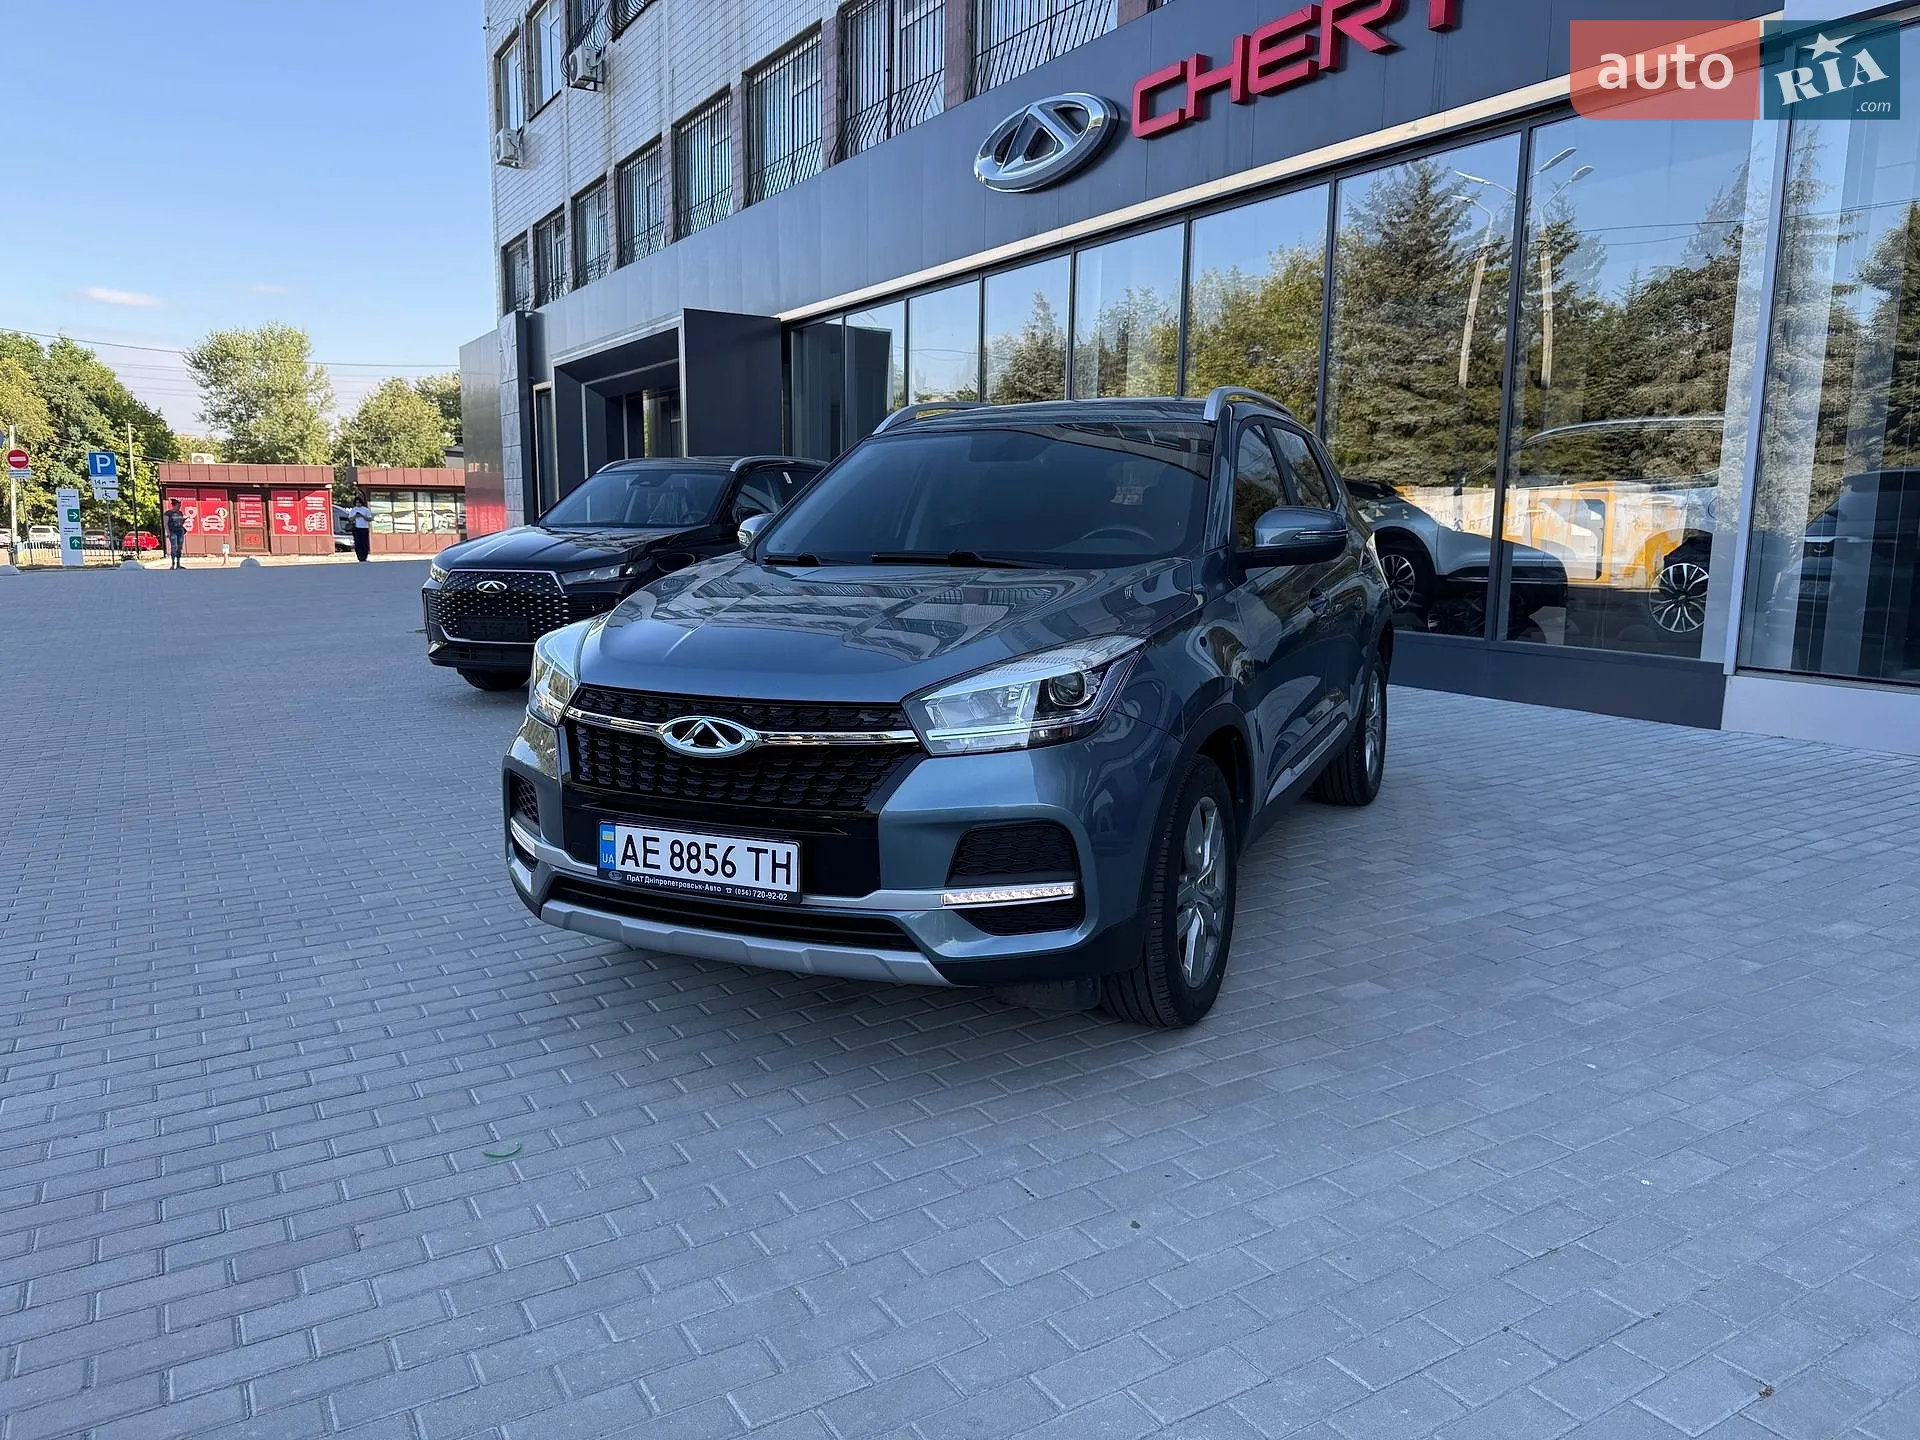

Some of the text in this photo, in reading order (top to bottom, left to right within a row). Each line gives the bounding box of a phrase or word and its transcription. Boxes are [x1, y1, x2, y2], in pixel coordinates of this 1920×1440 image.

[95, 454, 111, 474] P
[602, 853, 615, 865] UA
[620, 834, 792, 886] AE 8856 TH
[626, 874, 644, 883] ПрАТ
[644, 876, 722, 893] Дніпропетровськ-Авто
[734, 886, 752, 898] (056)
[752, 890, 788, 901] 720-92-02
